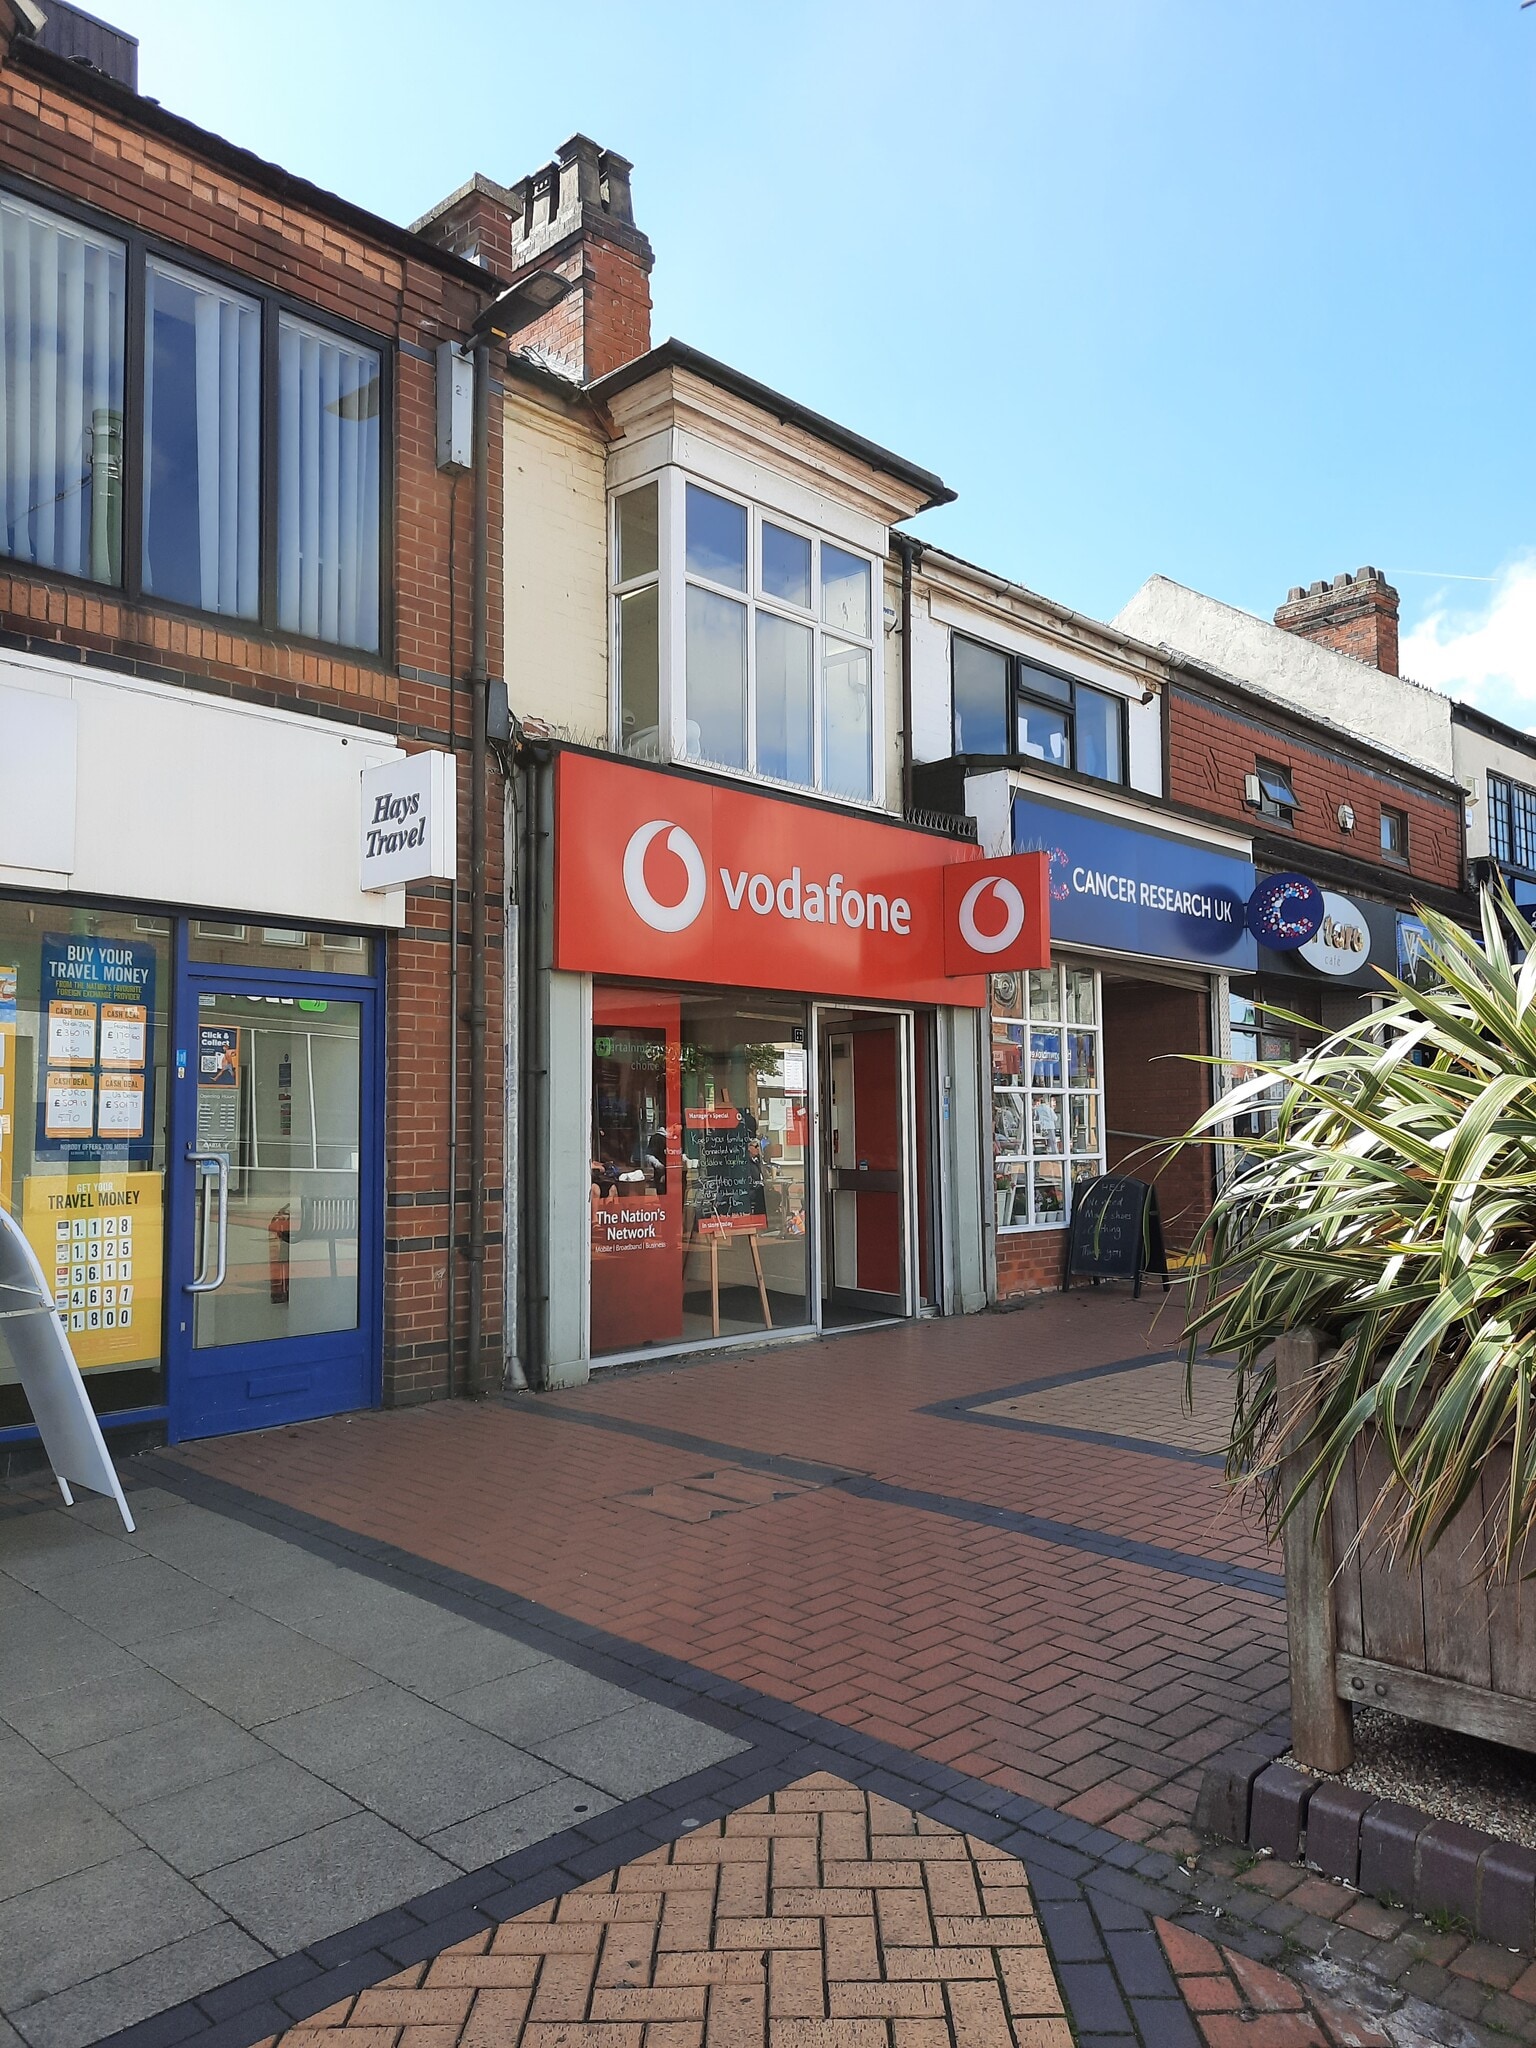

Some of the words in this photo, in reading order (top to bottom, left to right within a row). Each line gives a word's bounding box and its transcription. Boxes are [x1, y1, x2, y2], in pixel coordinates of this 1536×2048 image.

[371, 792, 420, 825] Hays
[366, 816, 426, 859] Travel
[719, 866, 911, 935] vodafone
[1072, 867, 1136, 904] CANCER
[1140, 882, 1211, 919] RESEARCH
[1214, 899, 1233, 923] UK
[67, 945, 94, 962] BUY
[99, 948, 133, 965] YOUR
[49, 961, 99, 980] TRAVEL
[103, 966, 149, 984] MONEY
[55, 980, 73, 989] FROM
[74, 981, 84, 989] THE
[113, 984, 143, 994] FAVOURITE
[57, 988, 81, 997] FOREIGN
[83, 989, 111, 999] EXCHANGE
[114, 992, 141, 1001] PROVIDER
[55, 1007, 73, 1016] CASH
[74, 1008, 90, 1017] DEAL
[106, 1010, 123, 1019] CASH
[201, 1031, 222, 1039] Click
[201, 1039, 230, 1047] Collect
[53, 1077, 71, 1086] CASH
[72, 1078, 88, 1086] DEAL
[105, 1079, 122, 1088] CASH
[123, 1080, 139, 1089] DEAL
[60, 1143, 81, 1151] NOBODY
[82, 1143, 102, 1151] OFFERS
[76, 1183, 91, 1193] GET
[94, 1182, 114, 1192] YOUR
[48, 1194, 94, 1210] TRAVEL
[98, 1190, 140, 1207] MONEY
[596, 1210, 619, 1225] The
[621, 1207, 666, 1224] Nation's
[607, 1223, 656, 1241] Network
[595, 1244, 613, 1253] Mobile
[615, 1243, 642, 1252] Broadband
[645, 1240, 667, 1250] Business
